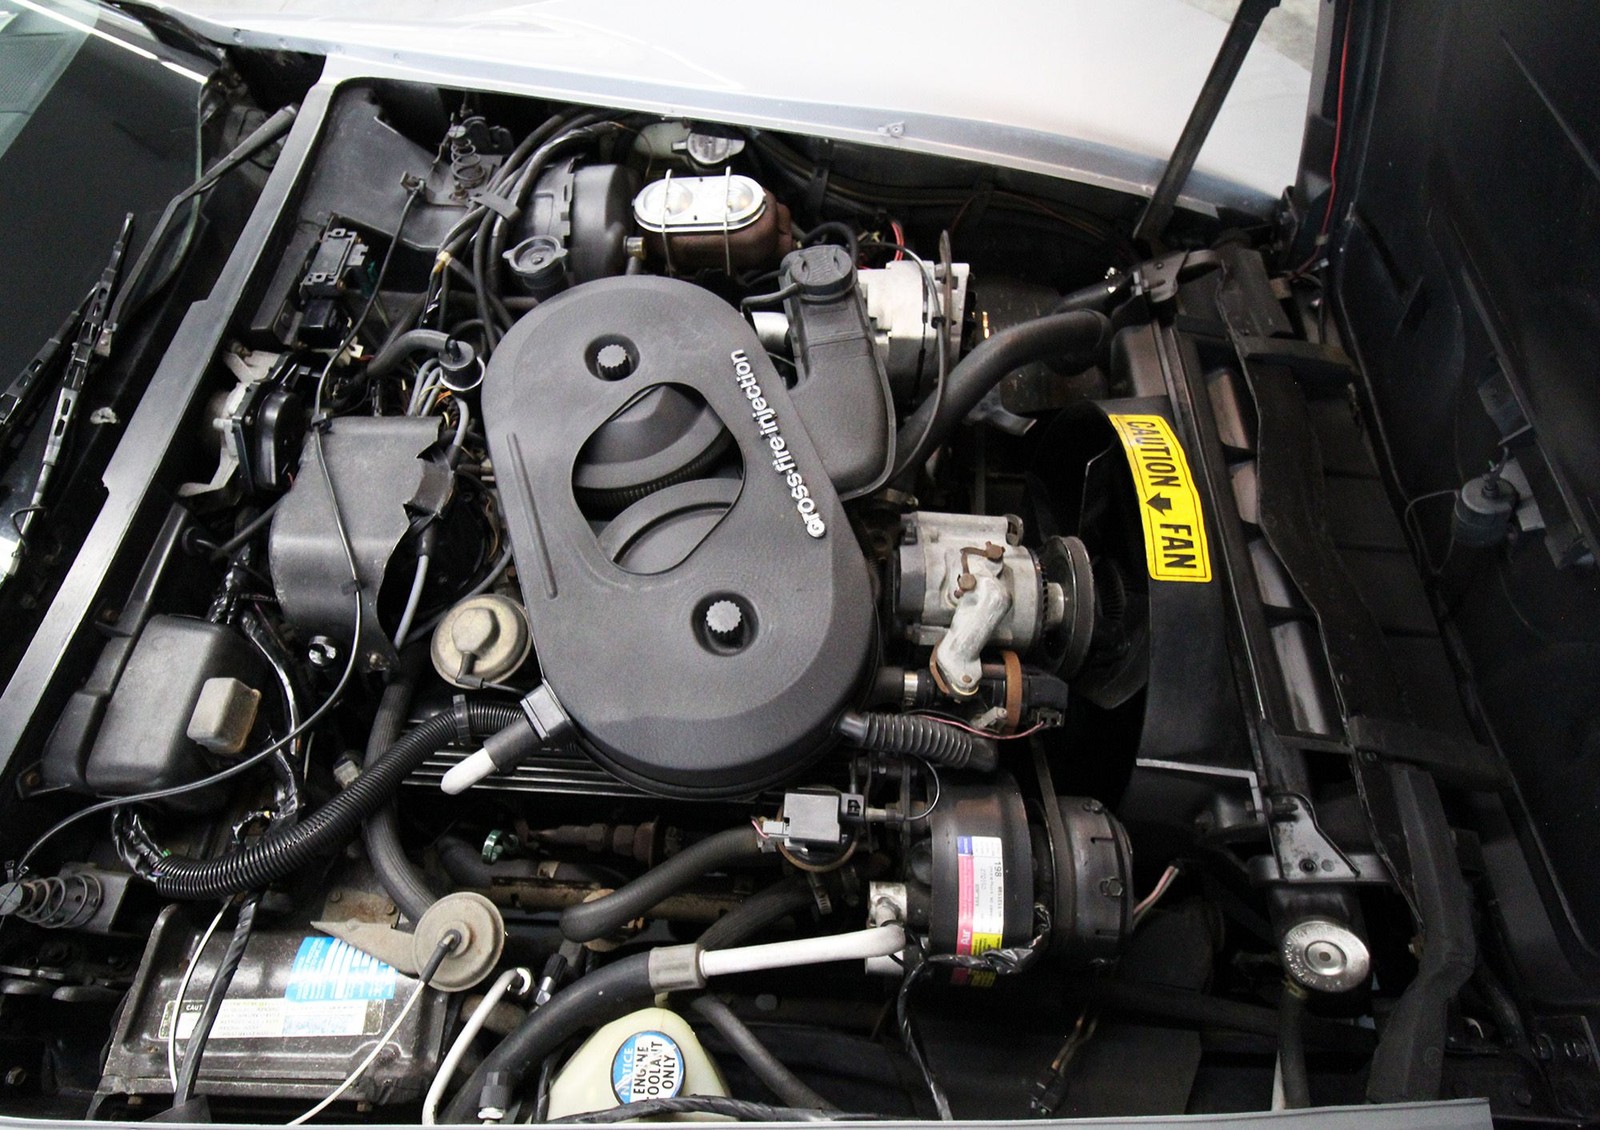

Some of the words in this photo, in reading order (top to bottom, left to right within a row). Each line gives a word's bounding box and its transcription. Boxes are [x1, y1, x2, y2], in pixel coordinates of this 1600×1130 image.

[731, 349, 779, 437] injection
[1127, 421, 1182, 488] CAUTION
[1160, 523, 1197, 569] FAN
[662, 1055, 676, 1090] ONLY
